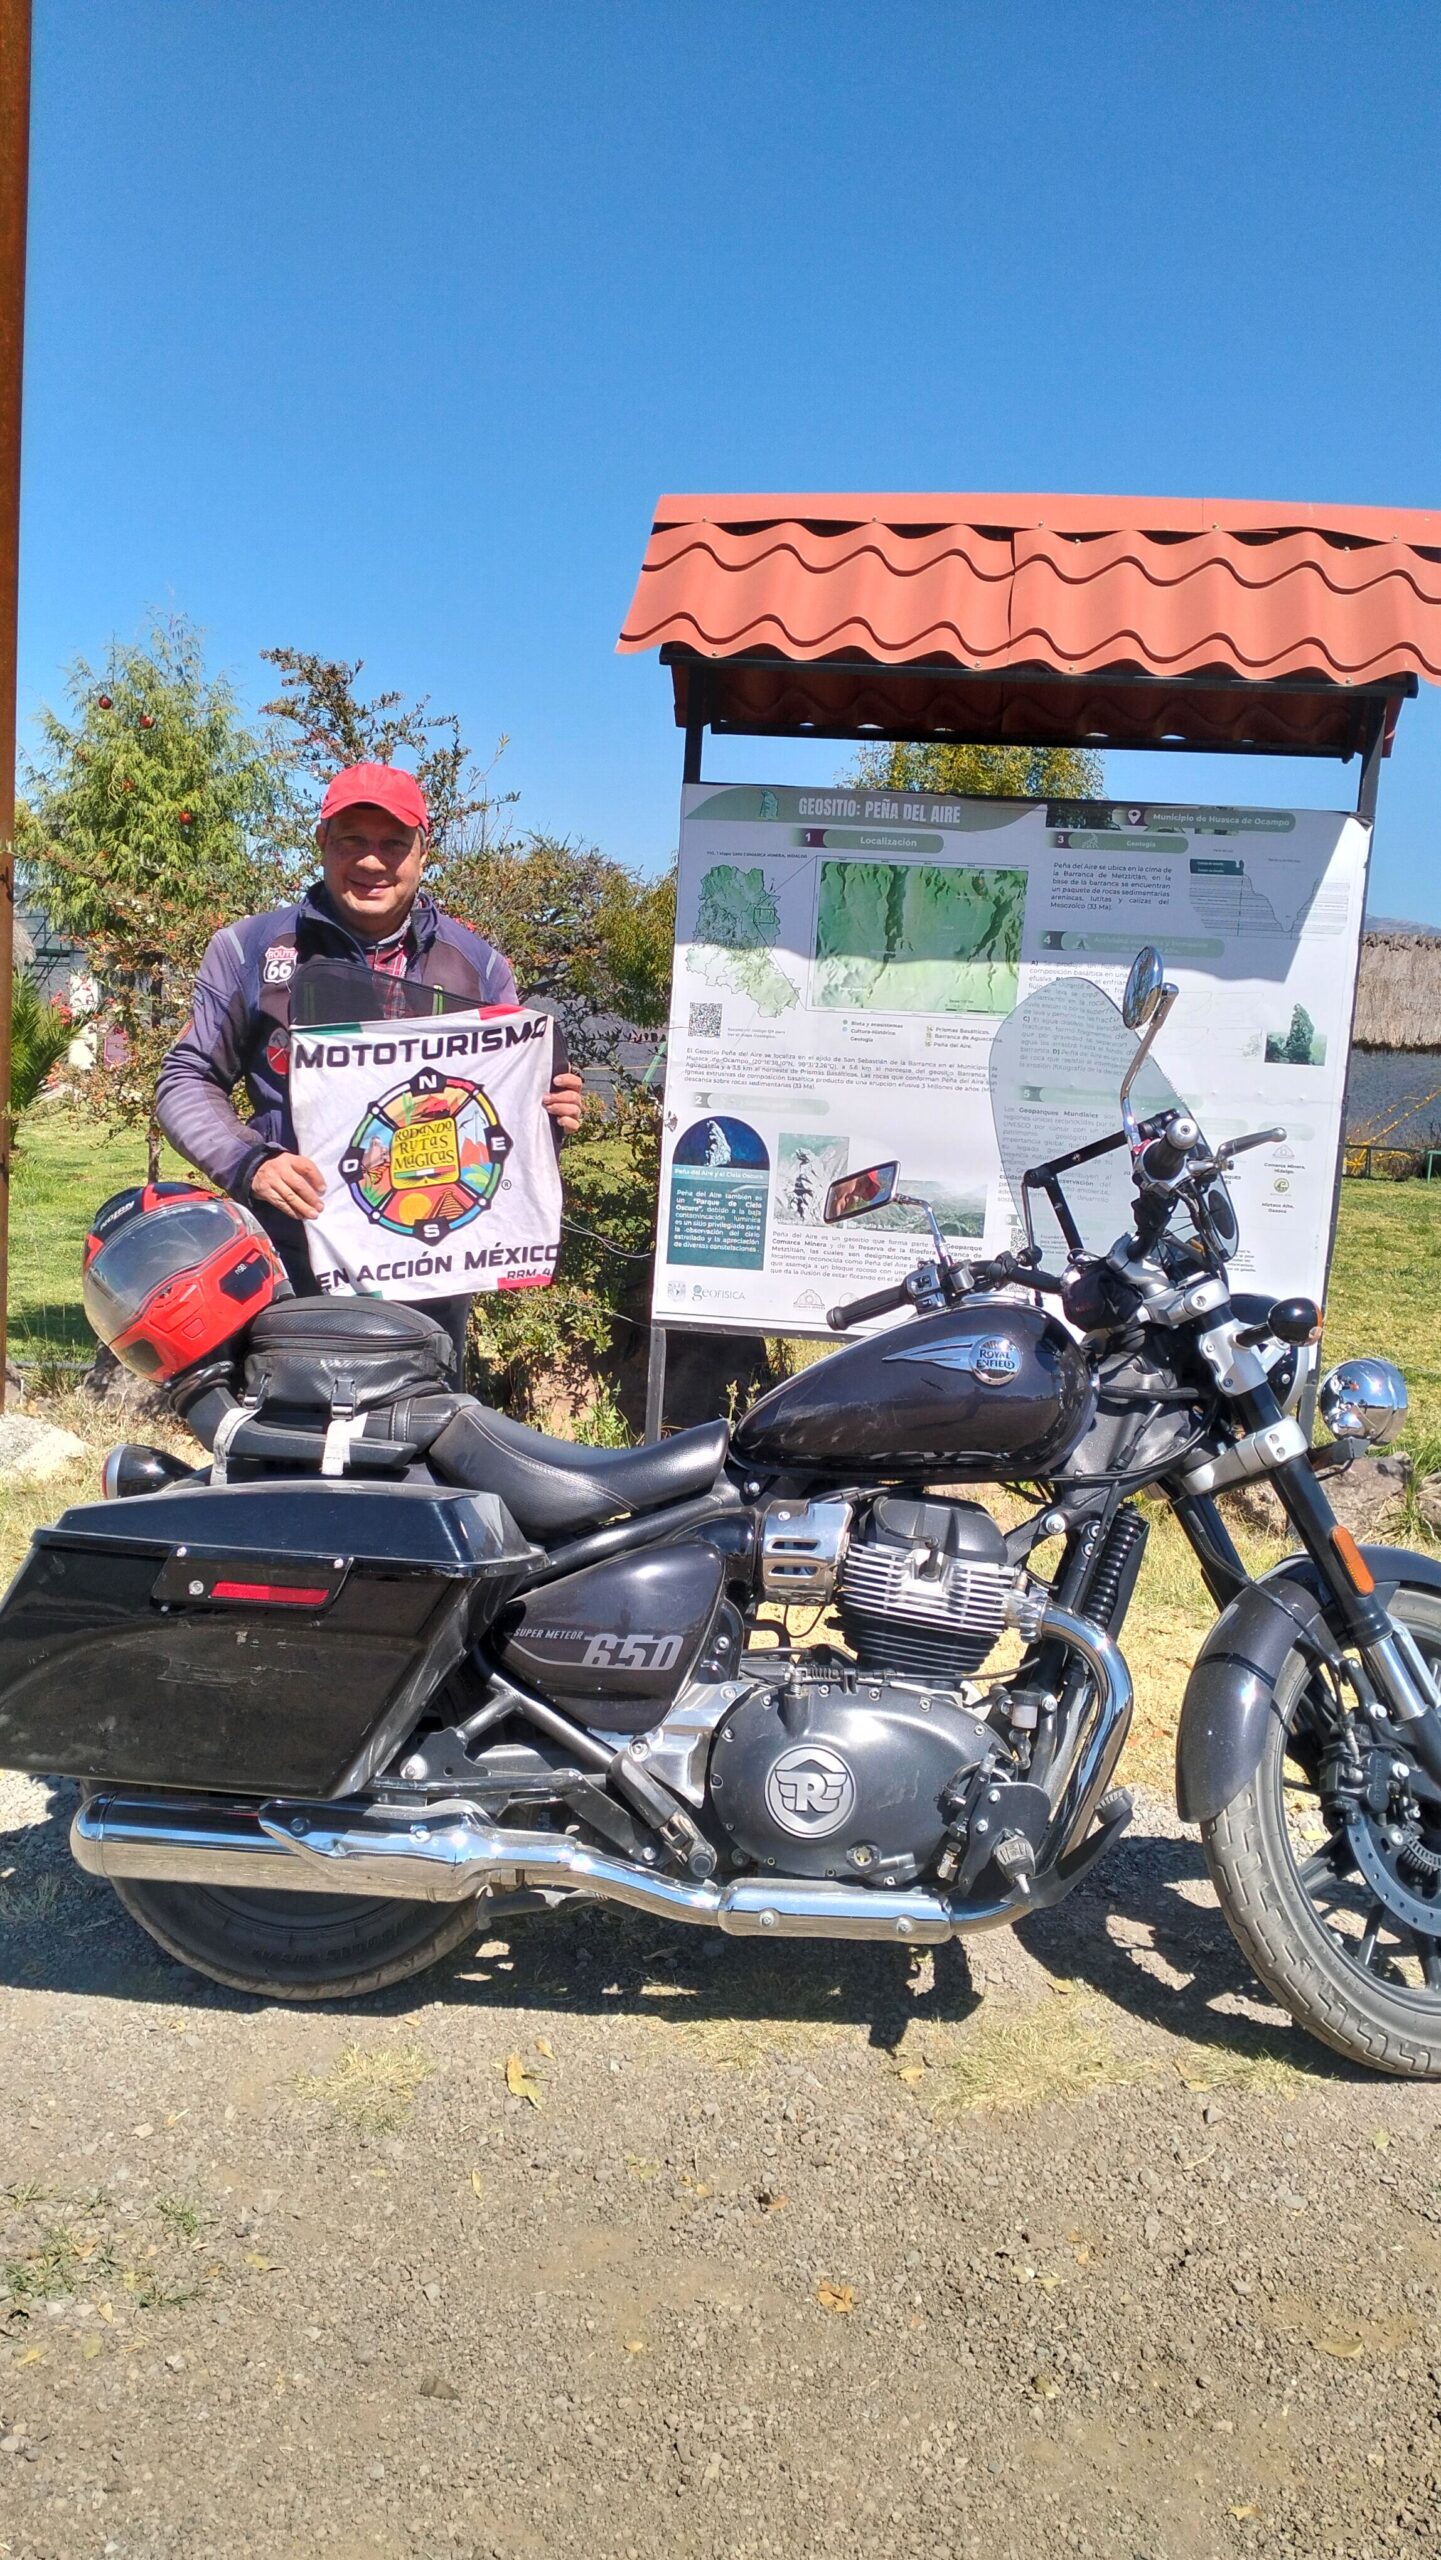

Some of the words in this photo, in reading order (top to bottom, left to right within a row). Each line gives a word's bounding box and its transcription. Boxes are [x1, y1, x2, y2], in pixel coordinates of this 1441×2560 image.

[799, 797, 860, 817] GEOSITIO:
[865, 799, 898, 819] PEÑA
[903, 804, 927, 821] DEL
[931, 805, 961, 824] AIRE
[1153, 813, 1195, 823] Municipio
[1196, 814, 1206, 823] de
[1208, 814, 1244, 824] Huasca
[1245, 816, 1253, 825] de
[1254, 817, 1290, 827] Ocampo
[805, 832, 811, 842] 1
[860, 836, 917, 848] Localización
[1057, 835, 1065, 844] 3
[1126, 839, 1157, 850] Geología
[1053, 862, 1071, 870] Peña
[1084, 863, 1098, 871] Aire
[1108, 864, 1127, 872] ubica
[1145, 866, 1162, 874] cima
[1063, 871, 1094, 879] Barranca
[1089, 880, 1119, 888] barranca
[1130, 882, 1171, 890] encuentran
[1062, 887, 1091, 896] paquete
[1122, 889, 1170, 898] sedimentarias
[1128, 897, 1152, 905] calizas
[1043, 935, 1051, 944] 4
[268, 949, 296, 958] ROUTE
[267, 960, 292, 980] 66
[1029, 968, 1074, 976] composición
[294, 1016, 549, 1070] MOTOTURISMO
[419, 1074, 438, 1089] N
[1023, 1090, 1030, 1098] 5
[695, 1096, 702, 1104] 2
[1018, 1106, 1059, 1118] Geoparques
[492, 1137, 506, 1150] E
[342, 1159, 359, 1173] O
[423, 1224, 440, 1238] S
[685, 1227, 723, 1235] observación
[707, 1221, 745, 1230] privilegiado
[772, 1231, 789, 1239] Peña
[805, 1233, 818, 1241] Aire
[771, 1238, 802, 1246] Comarca
[804, 1240, 827, 1248] Minera
[316, 1267, 350, 1289] EN
[356, 1251, 452, 1282] ACCIÓN
[507, 1269, 537, 1280] RRM
[980, 1349, 1010, 1359] ROYAL
[976, 1359, 1015, 1370] ENFIELD
[513, 1628, 544, 1639] SUPER
[544, 1630, 585, 1641] METEOR
[582, 1633, 684, 1671] 650
